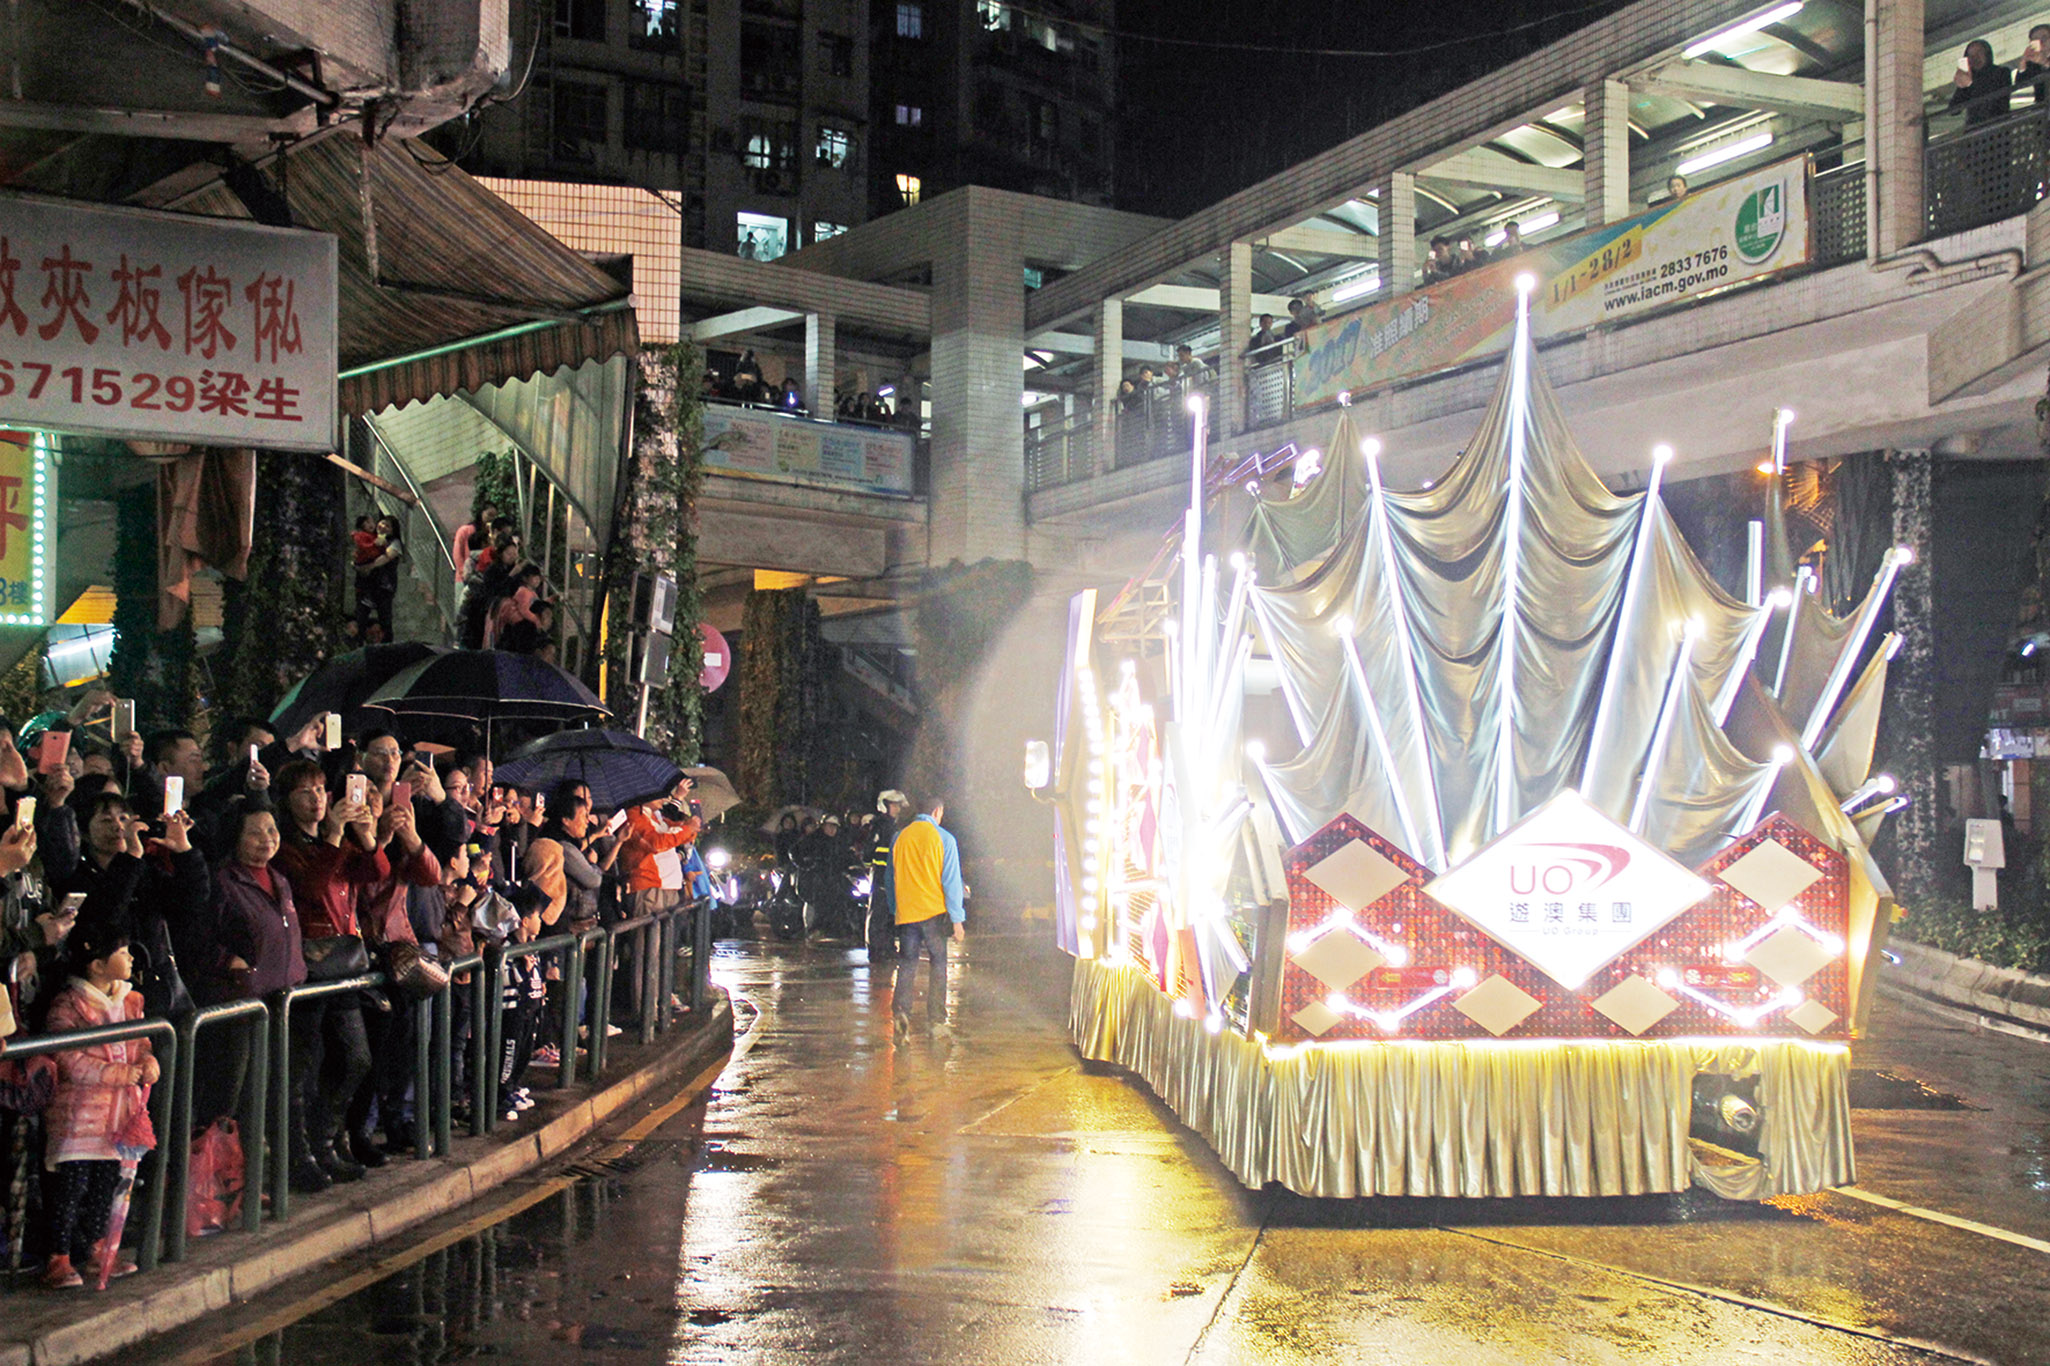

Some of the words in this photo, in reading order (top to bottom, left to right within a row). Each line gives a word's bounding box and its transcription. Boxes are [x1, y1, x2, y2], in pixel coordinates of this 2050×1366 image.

[1660, 257, 1692, 279] 2833
[1695, 245, 1728, 267] 7676
[1604, 264, 1729, 311] www.iacm.gov.mo
[1511, 865, 1573, 895] UO
[1543, 926, 1559, 936] UO
[1563, 926, 1599, 937] Group
